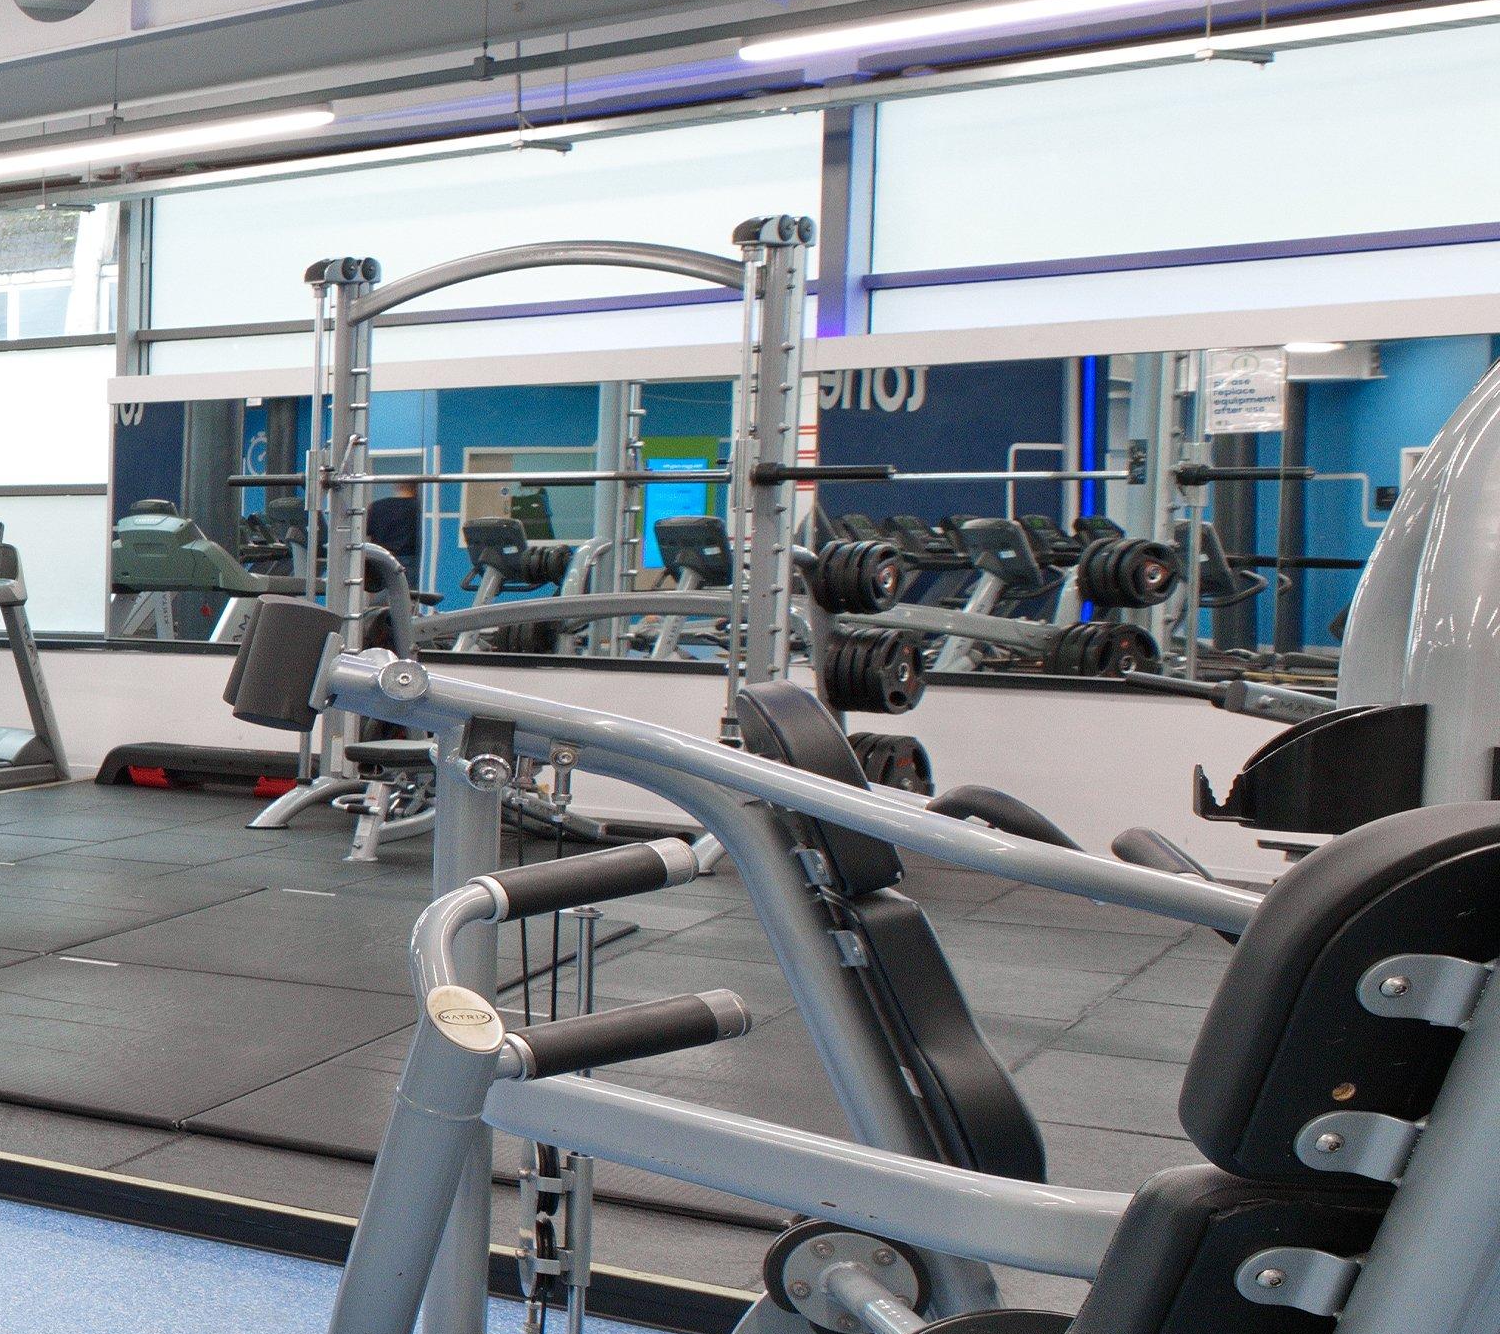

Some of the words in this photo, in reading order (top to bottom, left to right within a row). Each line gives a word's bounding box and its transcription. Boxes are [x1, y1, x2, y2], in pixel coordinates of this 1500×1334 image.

[1213, 388, 1255, 396] replace
[1213, 396, 1276, 405] equipment
[1214, 407, 1243, 415] after
